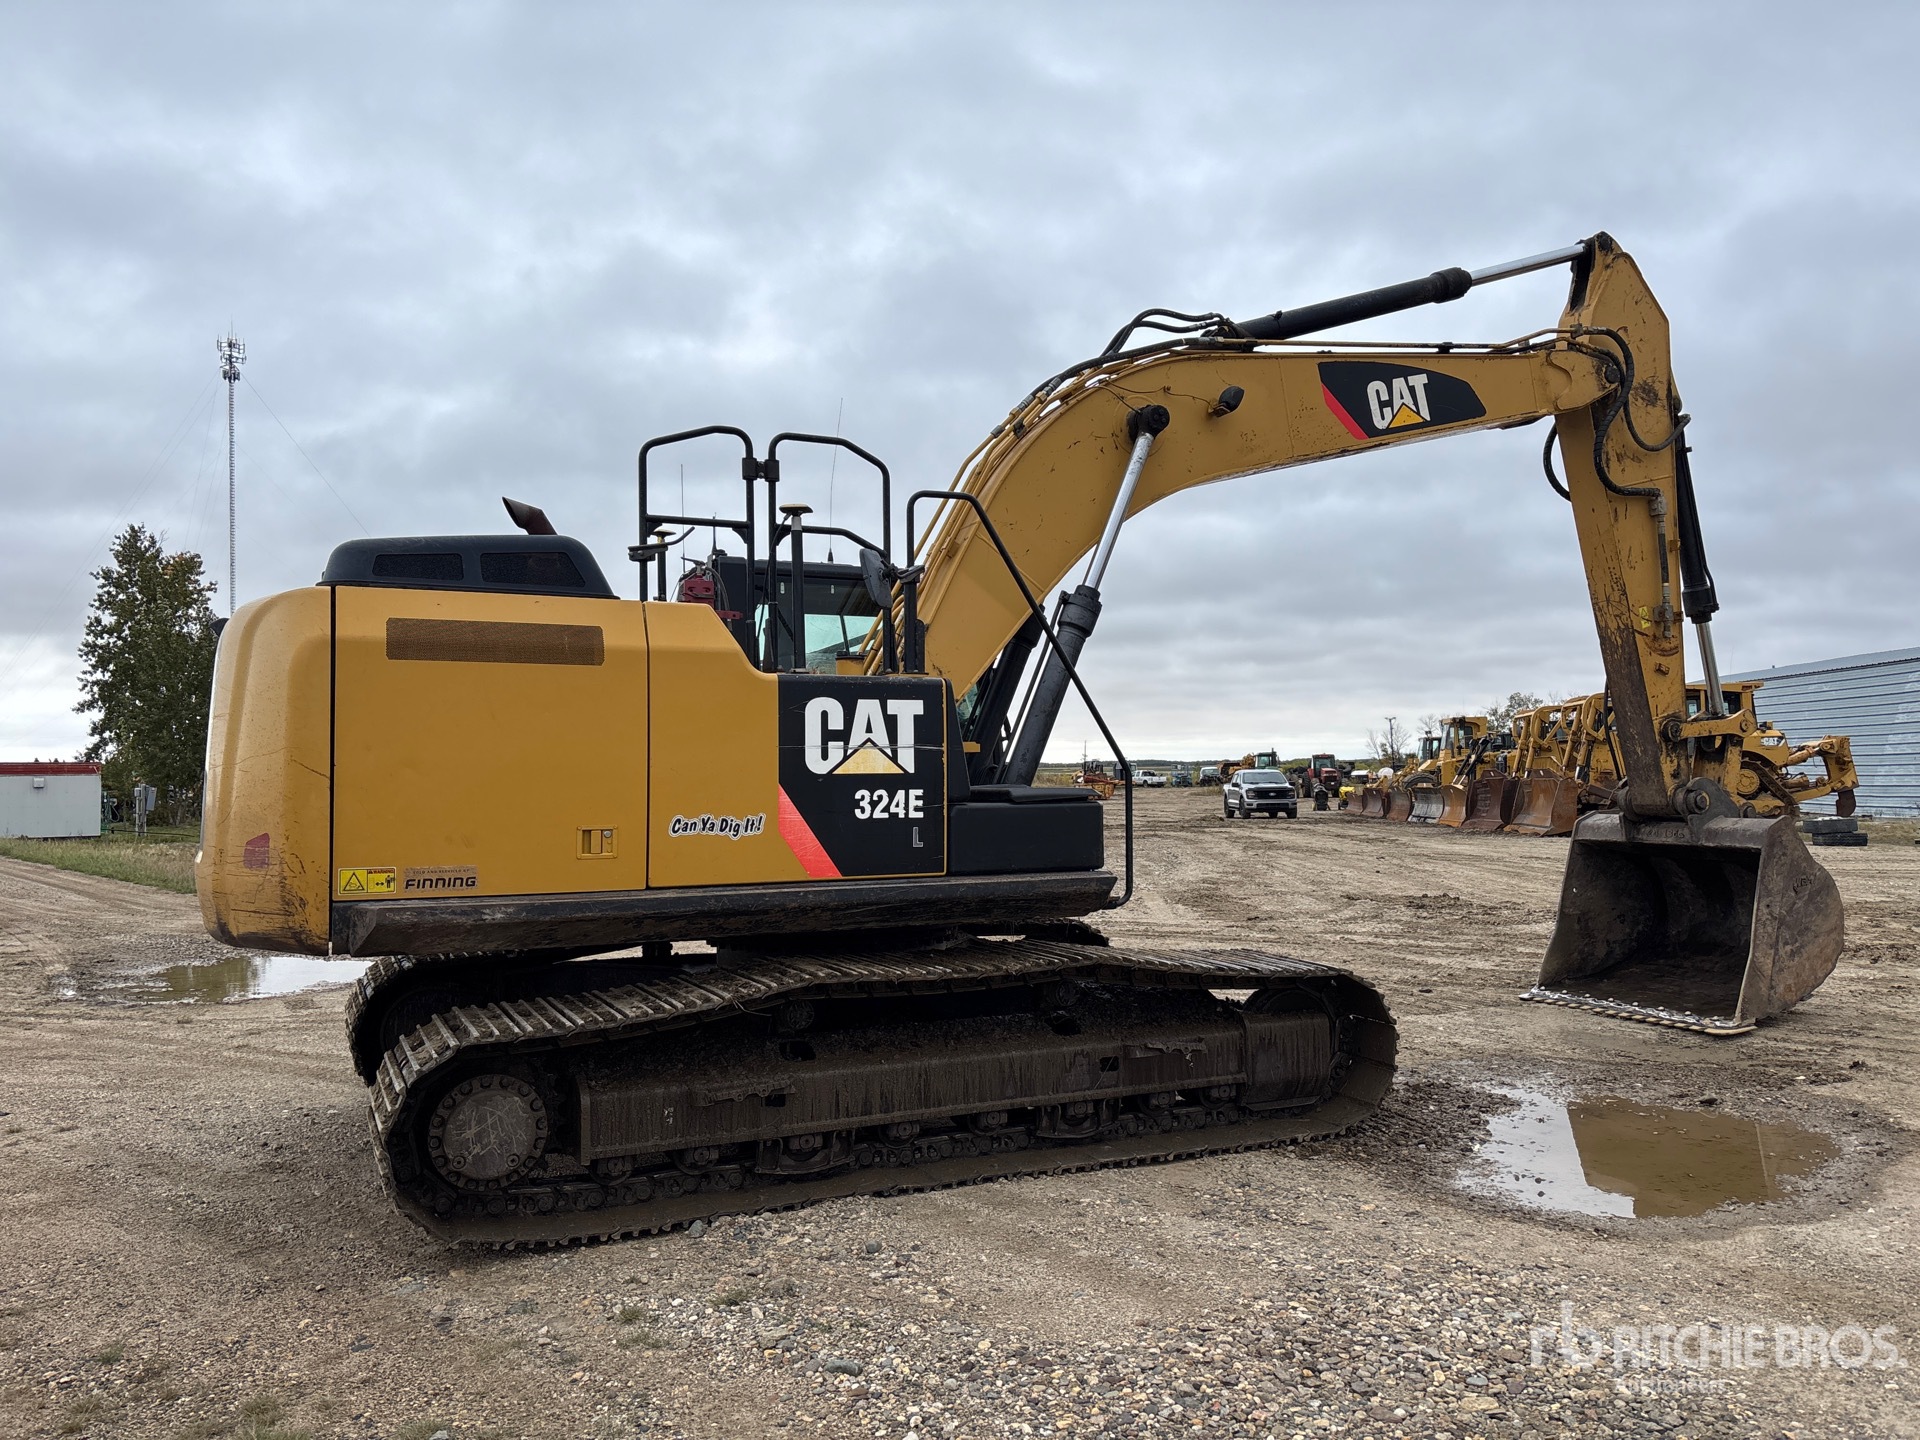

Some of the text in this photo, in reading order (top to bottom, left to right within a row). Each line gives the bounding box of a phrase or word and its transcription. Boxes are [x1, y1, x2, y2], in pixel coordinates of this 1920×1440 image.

[1366, 373, 1432, 430] CAT
[804, 696, 924, 774] CAT
[854, 788, 924, 820] 324E
[671, 815, 763, 837] Can Ya Dig It!
[911, 827, 924, 848] L
[405, 876, 477, 890] FINNING
